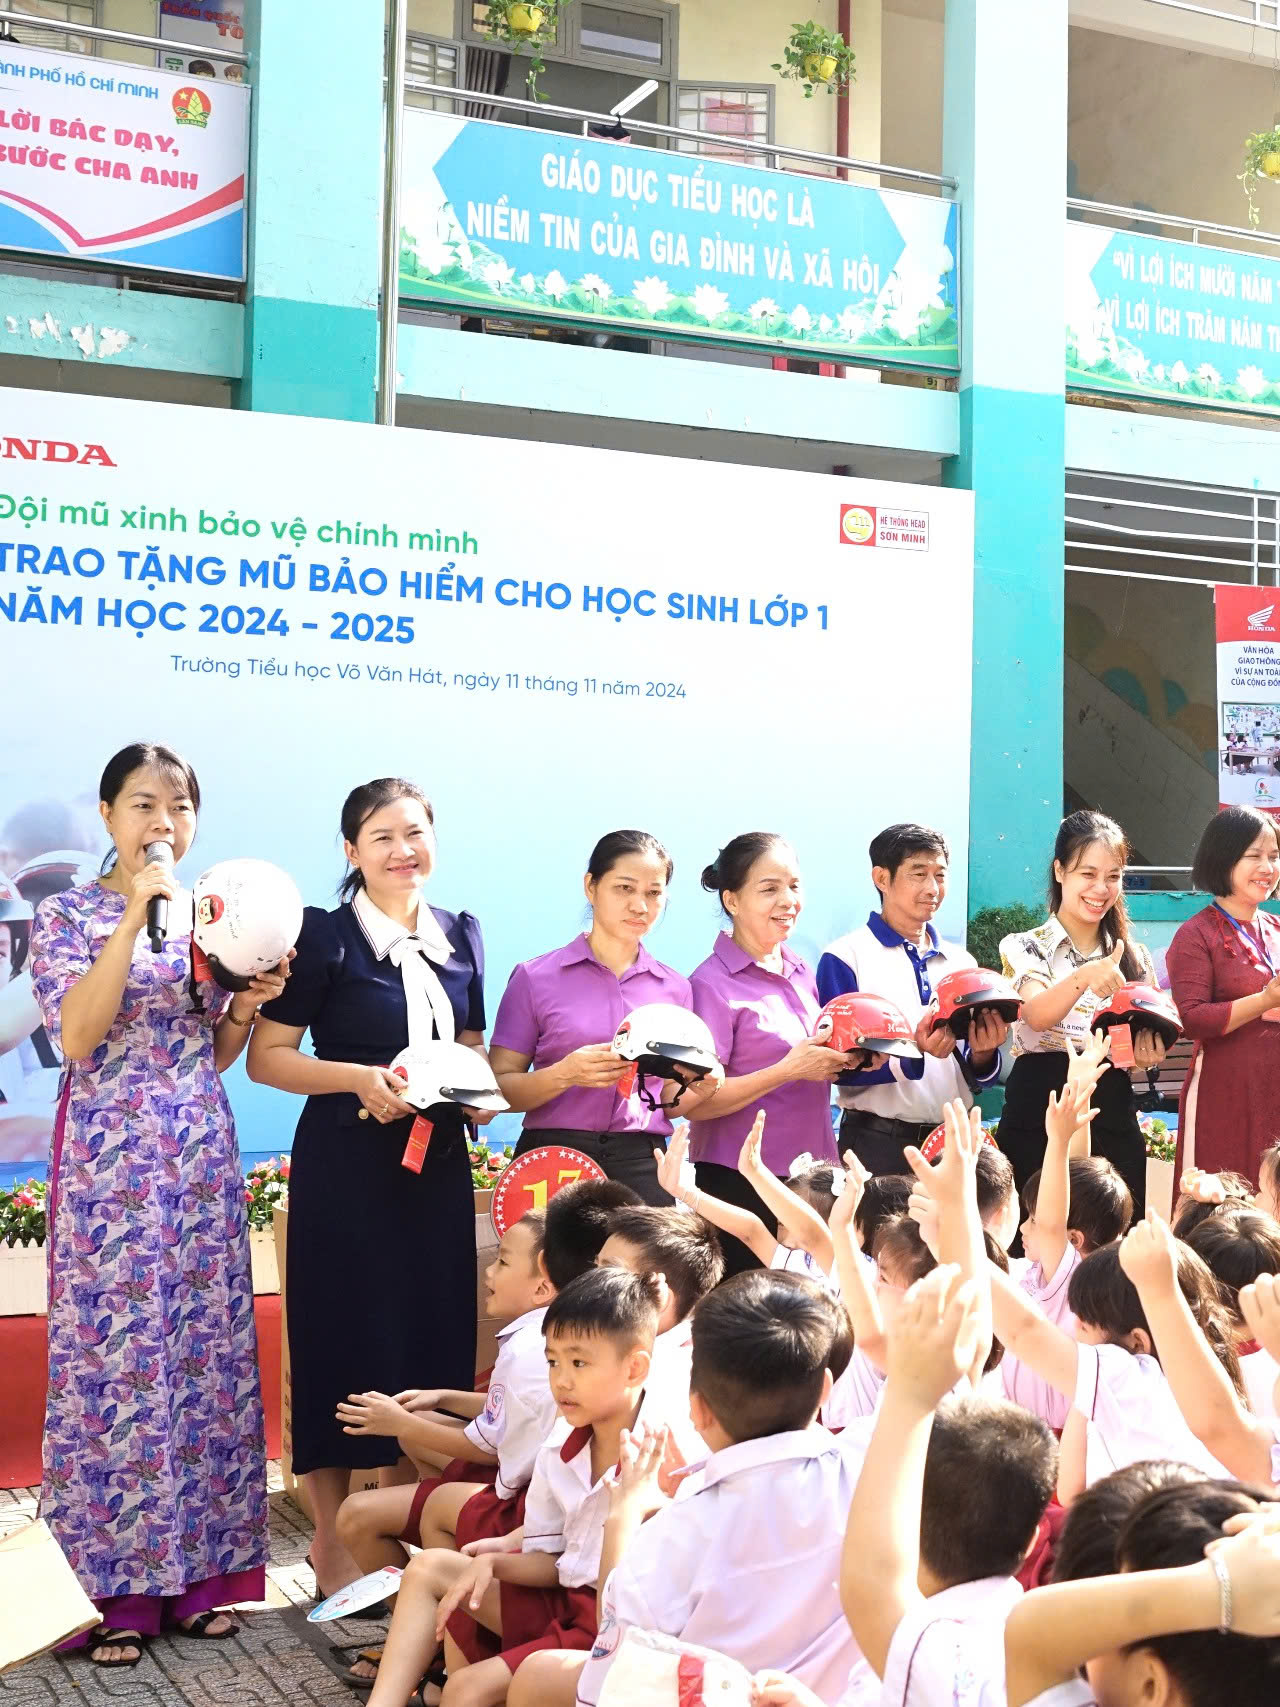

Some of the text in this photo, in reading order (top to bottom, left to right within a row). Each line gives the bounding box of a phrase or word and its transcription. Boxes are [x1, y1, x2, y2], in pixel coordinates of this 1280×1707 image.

[29, 66, 61, 83] PHỐ
[65, 71, 86, 87] HỒ
[90, 77, 114, 93] CHÍ
[118, 82, 159, 100] MINH
[0, 108, 180, 157] LỜI BÁC DẠY,
[75, 156, 131, 181] CHA
[140, 166, 198, 191] ANH
[541, 150, 815, 229] GIÁO DỤC TIỂU HỌC LÀ
[466, 193, 530, 244] NIỀM
[540, 214, 580, 251] TIN
[591, 210, 640, 260] CỦA
[649, 229, 690, 267] GIA
[700, 232, 754, 277] ĐÌNH
[764, 240, 794, 282] VÀ
[804, 248, 833, 288] XÃ
[1170, 253, 1194, 290] ÍCH
[1242, 270, 1273, 304] NĂM
[1126, 296, 1149, 341] LỢI
[1155, 299, 1180, 337] ÍCH
[1231, 314, 1263, 349] NĂM
[0, 436, 118, 468] NDA
[0, 494, 479, 555] Đội mũ xinh bảo vệ chính mình
[901, 533, 926, 544] MINH
[910, 518, 926, 529] HEAD
[0, 542, 829, 631] TRAO TẶNG MŨ BẢO HIỂM CHO HỌC SINH LỚP 1
[0, 585, 83, 626] NĂM
[97, 597, 186, 639] HỌC
[198, 604, 289, 637] 2024
[330, 611, 415, 645] 2025
[170, 655, 687, 699] Trường Tiểu học Võ Văn Hát, ngày 11 tháng 11 năm 2024
[1256, 657, 1280, 665] THÔNG
